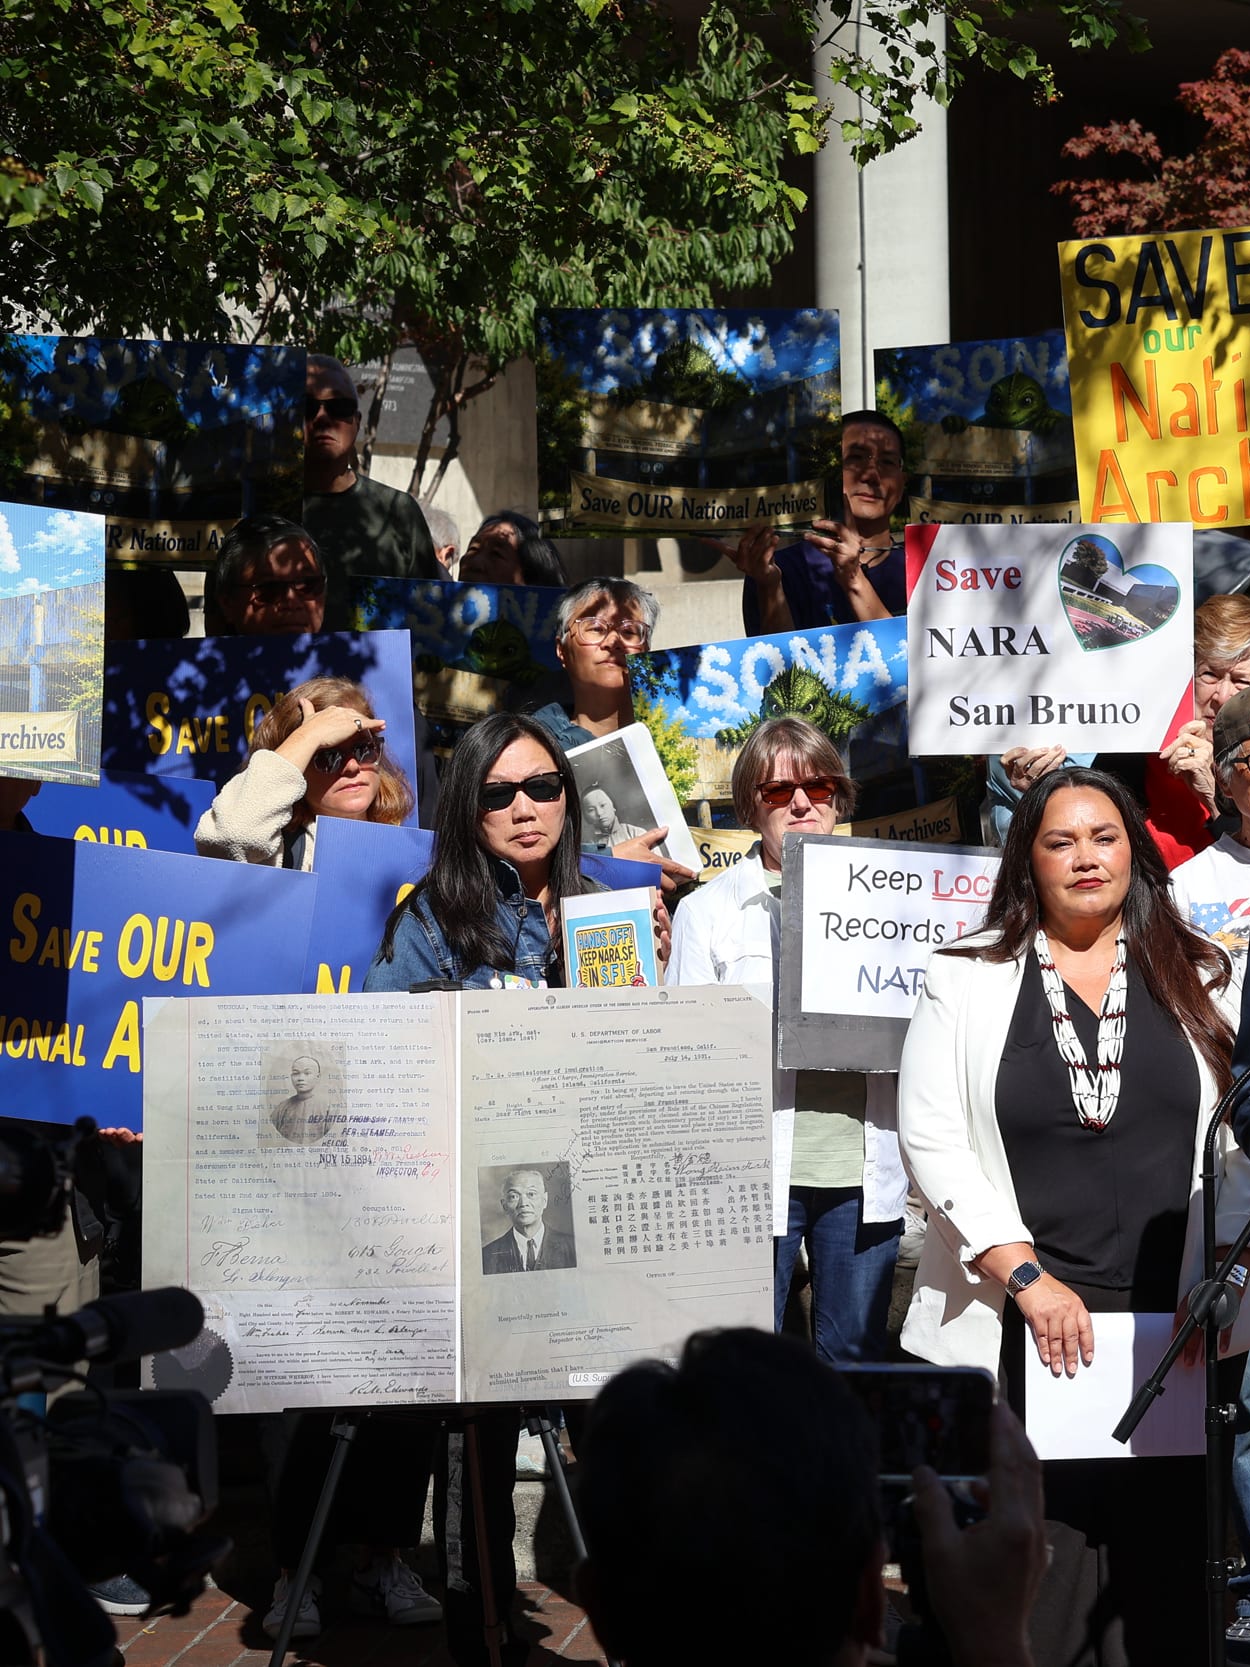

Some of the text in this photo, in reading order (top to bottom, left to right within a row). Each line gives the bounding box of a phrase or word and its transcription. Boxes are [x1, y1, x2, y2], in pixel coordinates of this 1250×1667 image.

[1143, 324, 1203, 354] our
[934, 340, 1051, 398] SON
[580, 488, 817, 521] Save OUR National Archives
[130, 529, 201, 551] National
[935, 559, 1022, 592] Save
[926, 625, 1051, 658] NARA
[692, 628, 893, 708] SONA
[145, 691, 231, 755] SAVE
[949, 694, 1141, 726] San Bruno
[0, 723, 66, 750] rchives
[887, 814, 951, 841] Archives
[699, 842, 743, 870] Save
[847, 863, 994, 898] Keep Loc
[9, 893, 215, 988] SAVE OUR
[576, 927, 633, 951] HANDS OFF!
[820, 912, 946, 945] Records
[579, 951, 597, 967] KEEP
[588, 967, 600, 987] IN
[857, 965, 926, 996] NAR
[589, 1029, 629, 1038] DEPARTMENT
[319, 1153, 338, 1165] NOV
[376, 1166, 419, 1180] INSPECTOR,
[489, 1377, 519, 1386] submitted
[504, 1370, 514, 1378] the
[515, 1368, 549, 1377] information
